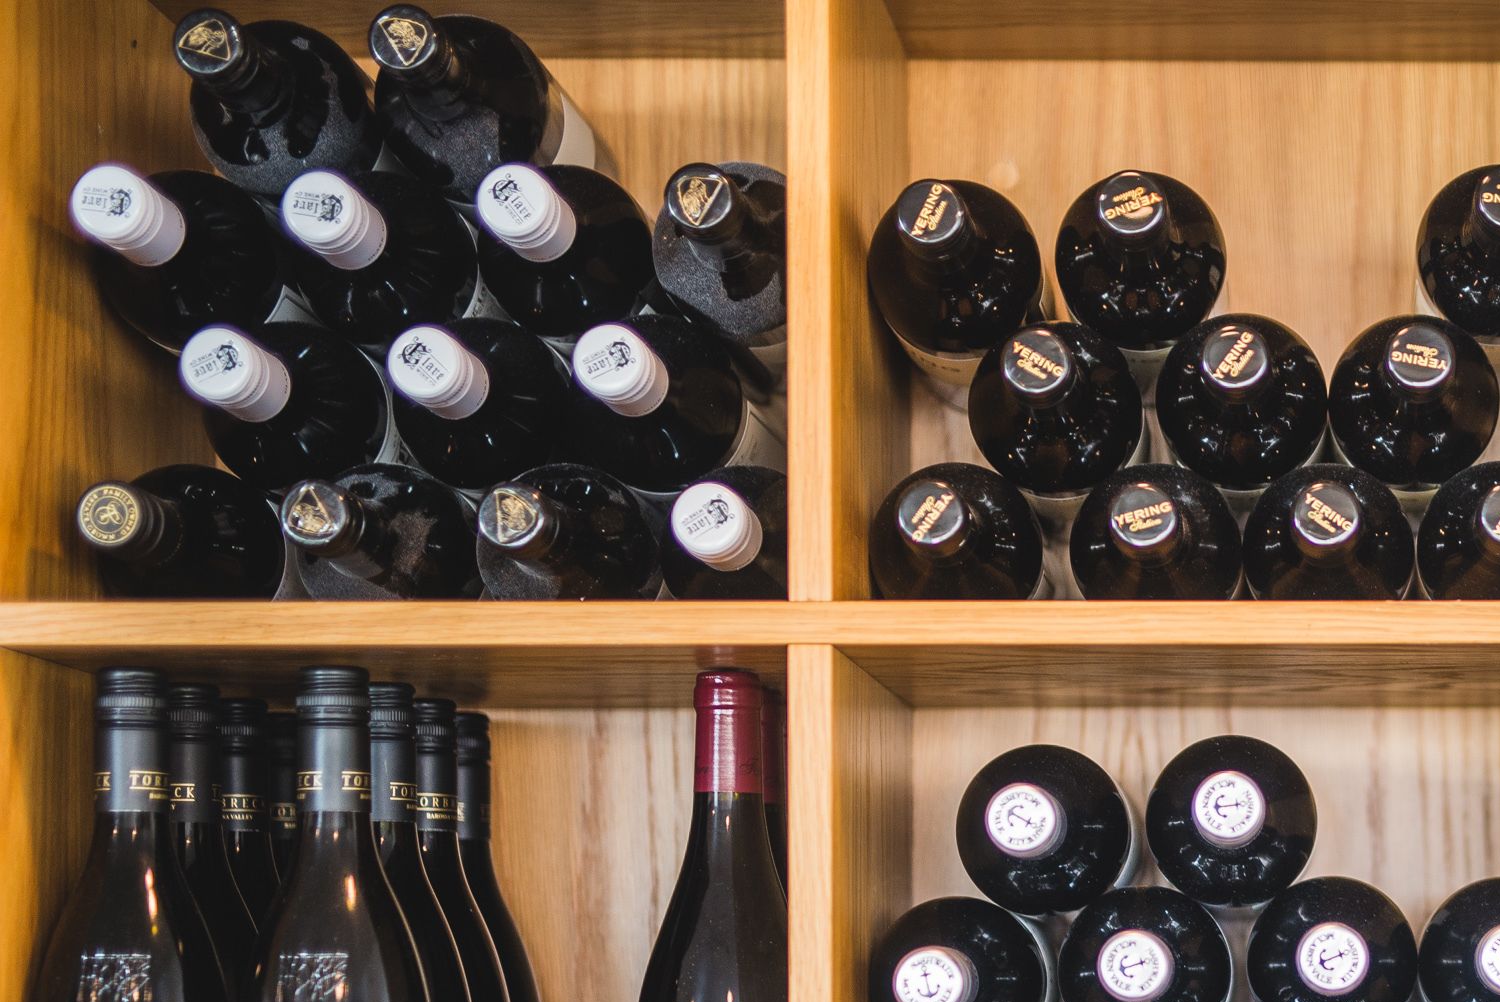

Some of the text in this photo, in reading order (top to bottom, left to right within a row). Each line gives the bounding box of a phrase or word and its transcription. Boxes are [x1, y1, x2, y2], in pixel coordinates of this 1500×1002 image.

[82, 188, 132, 218] Clare
[293, 194, 344, 224] Clare
[488, 173, 532, 220] Clare
[911, 183, 942, 236] YERING
[1104, 192, 1163, 220] YERING
[193, 340, 243, 378] Clare
[397, 336, 445, 380] Clare
[586, 338, 636, 374] Clare
[1012, 341, 1065, 377] YERING
[1213, 331, 1253, 379] YERING
[1391, 351, 1448, 370] YERING
[83, 493, 116, 540] ESTATE GROWN
[102, 489, 137, 536] FAMILY OWNED
[686, 494, 735, 534] Clare
[911, 493, 954, 542] YERING
[1114, 501, 1173, 528] YERING
[1305, 493, 1353, 531] YERING
[1204, 811, 1223, 832] VALE
[1229, 790, 1254, 833] NASHWAUK
[1340, 938, 1359, 983] NASHWAUK
